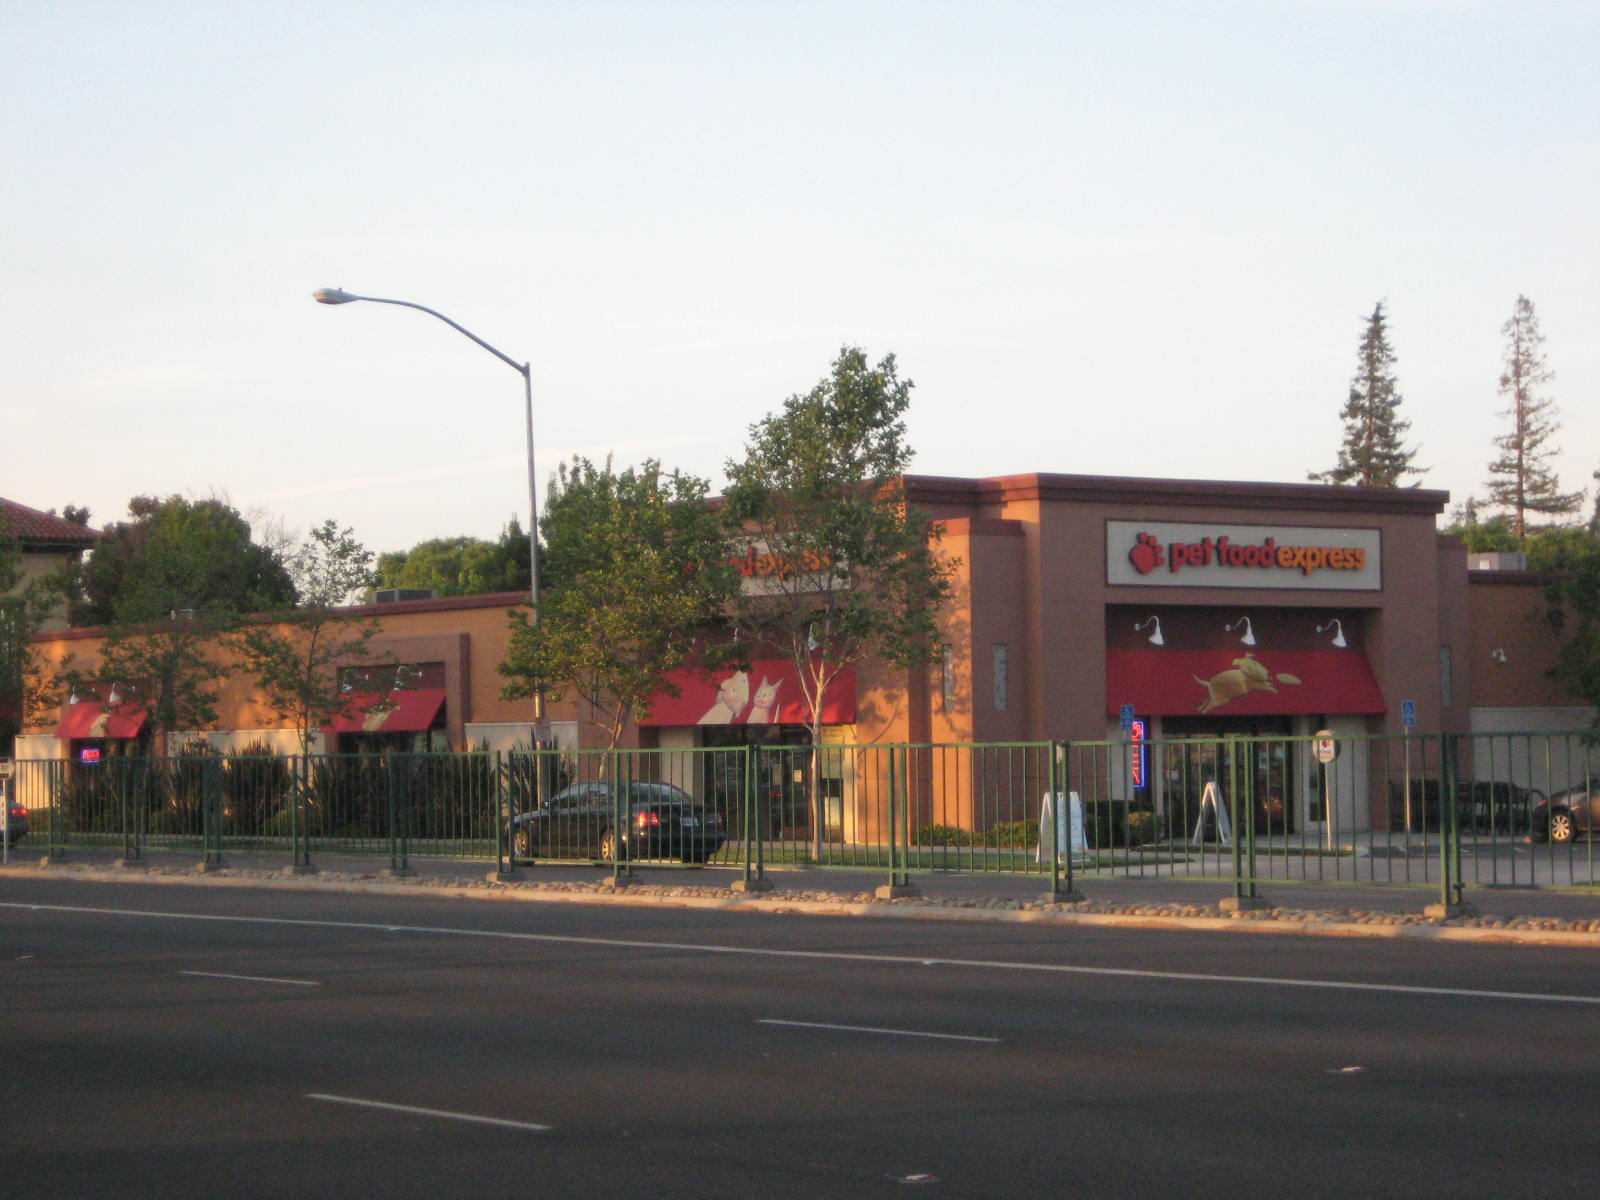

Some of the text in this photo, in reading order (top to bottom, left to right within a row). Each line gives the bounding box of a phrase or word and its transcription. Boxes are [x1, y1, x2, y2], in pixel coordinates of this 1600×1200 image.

[1169, 536, 1367, 576] pet food express
